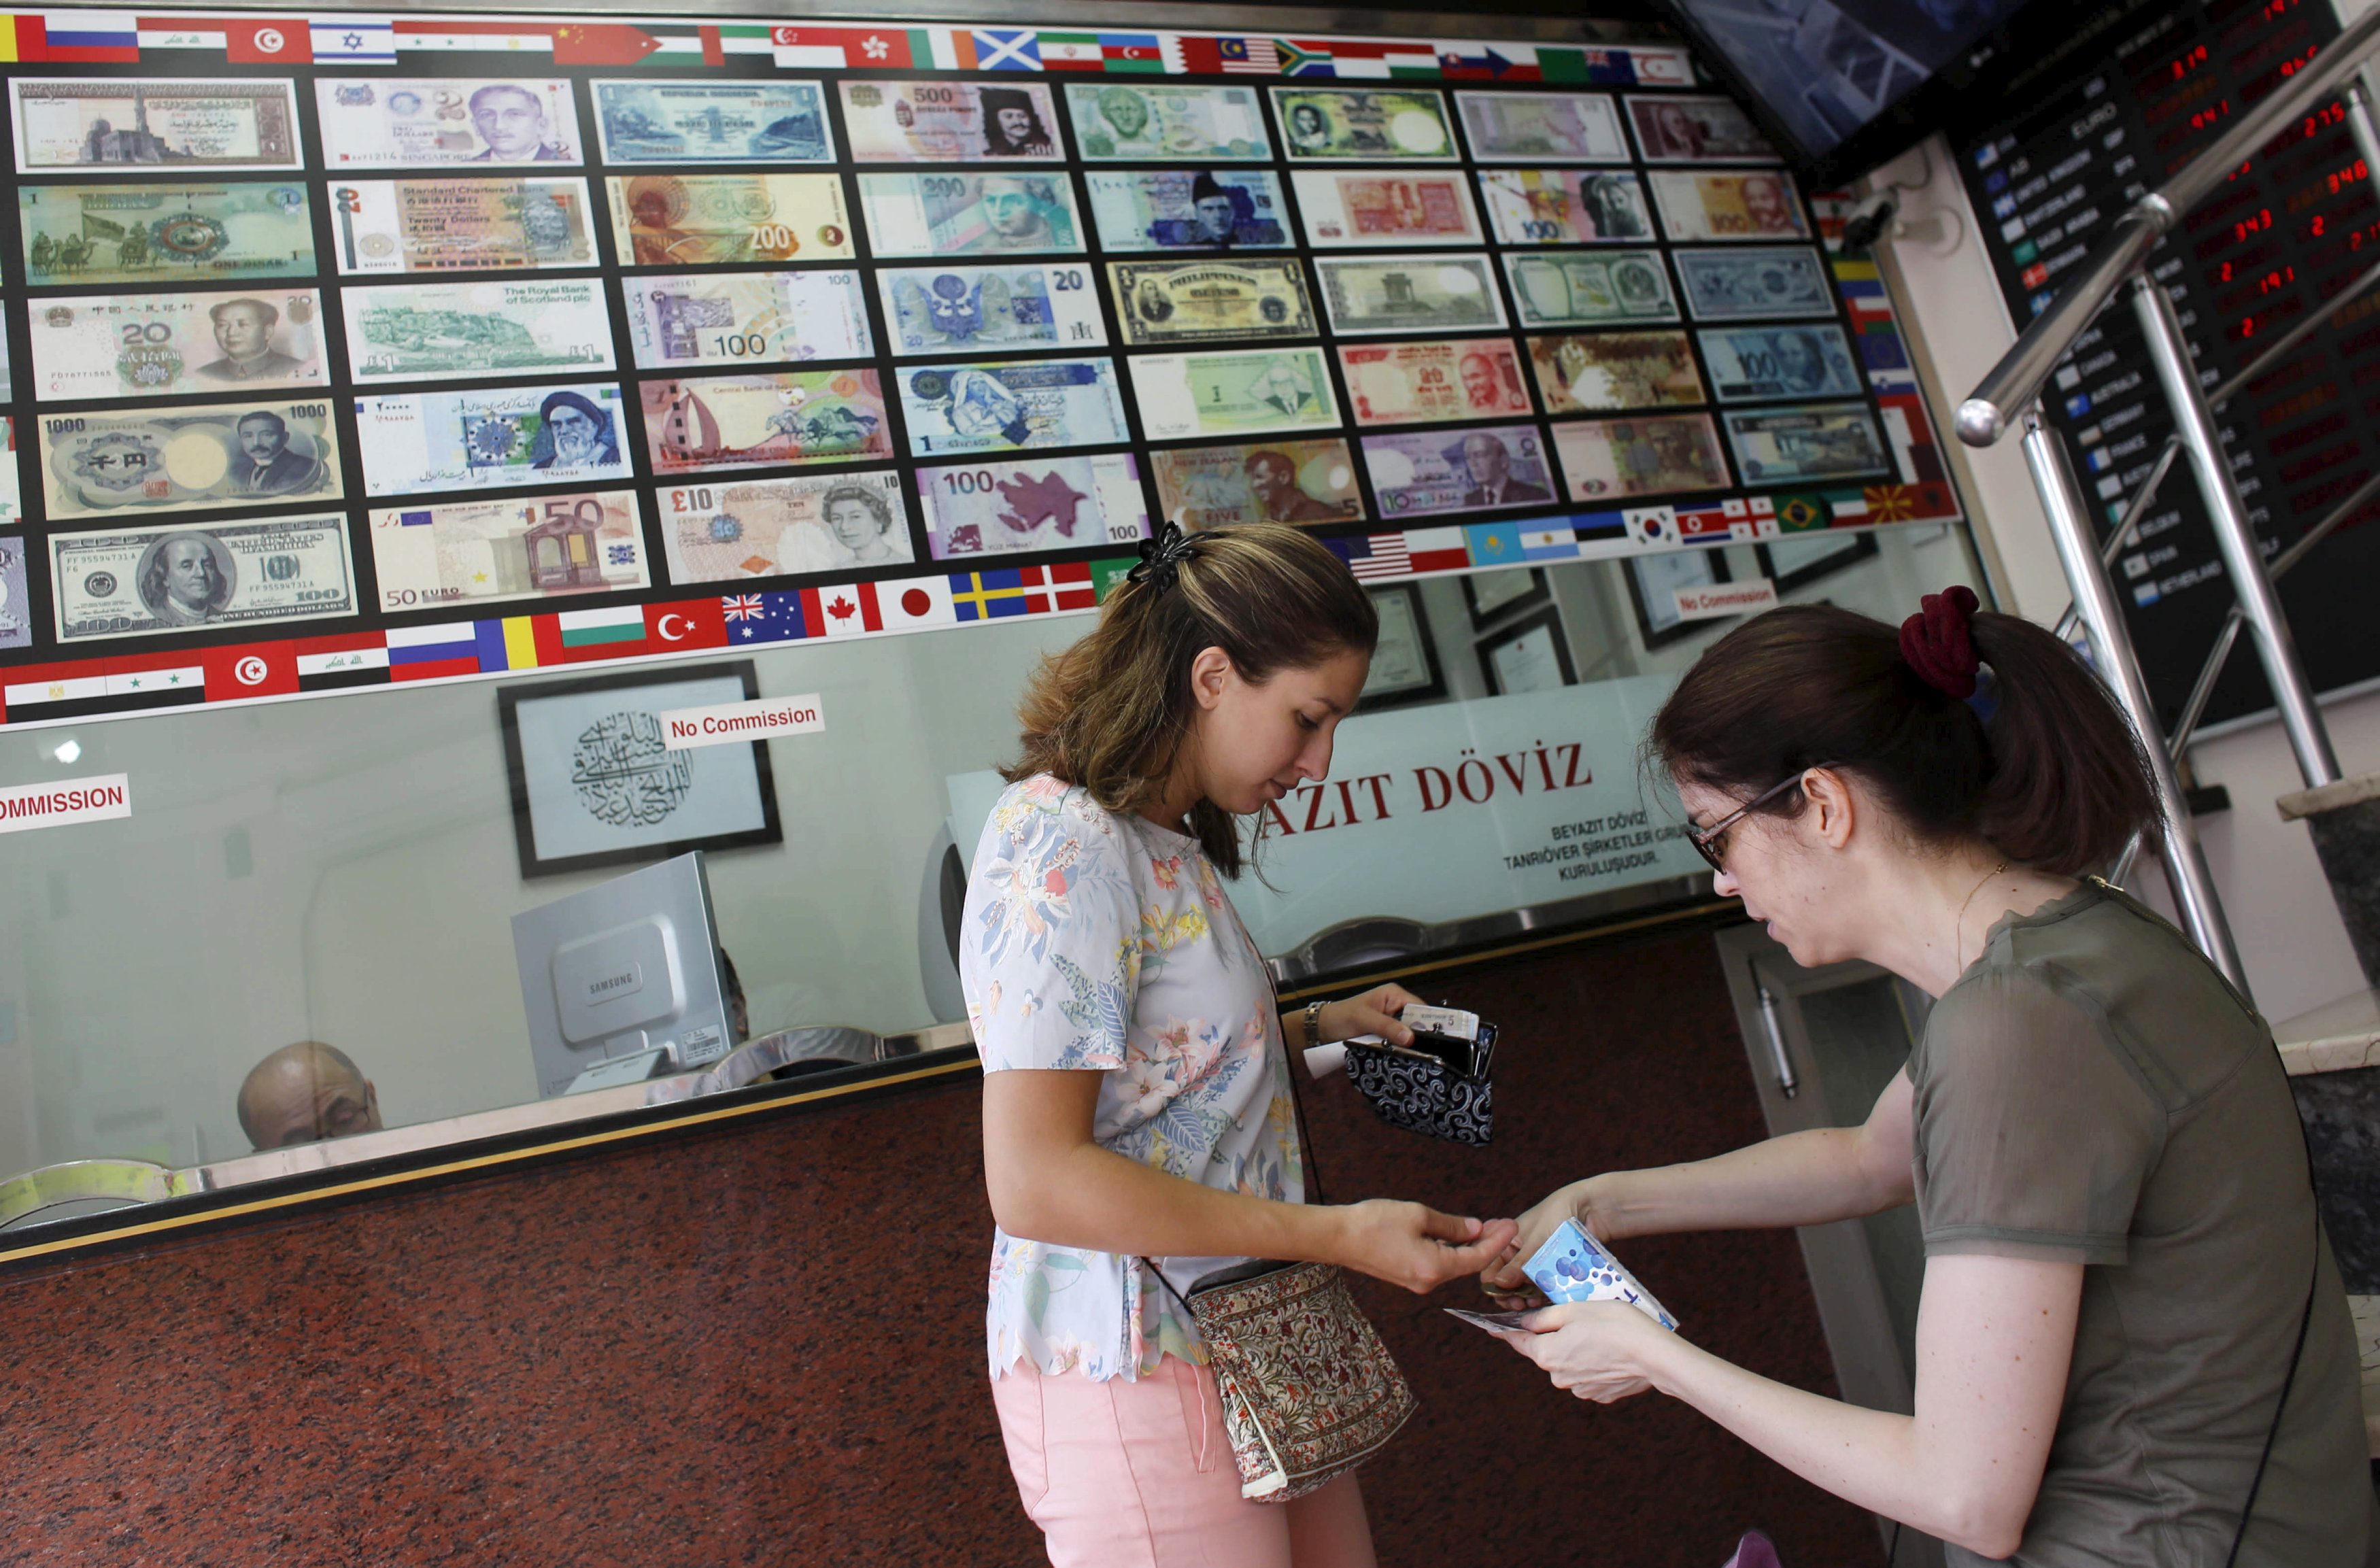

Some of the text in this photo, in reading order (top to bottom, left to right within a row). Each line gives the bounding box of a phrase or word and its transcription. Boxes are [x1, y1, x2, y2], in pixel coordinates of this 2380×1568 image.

[914, 88, 953, 103] 500
[403, 186, 456, 195] Standard
[458, 185, 514, 194] Chartered
[923, 178, 966, 197] 200
[409, 215, 490, 225] Twenty Dollars
[750, 226, 790, 250] 200
[503, 285, 590, 296] The Royal Bank
[828, 275, 851, 286] 100
[1053, 271, 1083, 290] 20
[506, 294, 590, 305] of Scotland plc
[122, 322, 172, 344] 20
[714, 334, 766, 357] 100
[290, 403, 327, 419] 1000
[46, 418, 86, 434] 1000
[884, 476, 898, 489] 10
[944, 470, 994, 494] 100
[671, 488, 713, 513] £10
[545, 498, 605, 532] 50
[1108, 525, 1138, 540] 100
[295, 588, 340, 602] 100
[387, 586, 460, 607] 50 EURO
[1680, 590, 1771, 611] No Commission
[671, 706, 816, 738] No Commission
[1238, 739, 1593, 843] AZIT DÖVİZ
[1551, 817, 1605, 842] BEYAZIT
[1503, 844, 1581, 870] TANRIÖVER
[1582, 828, 1653, 859] ŞİRKETLER
[589, 972, 633, 995] SAMSUNG
